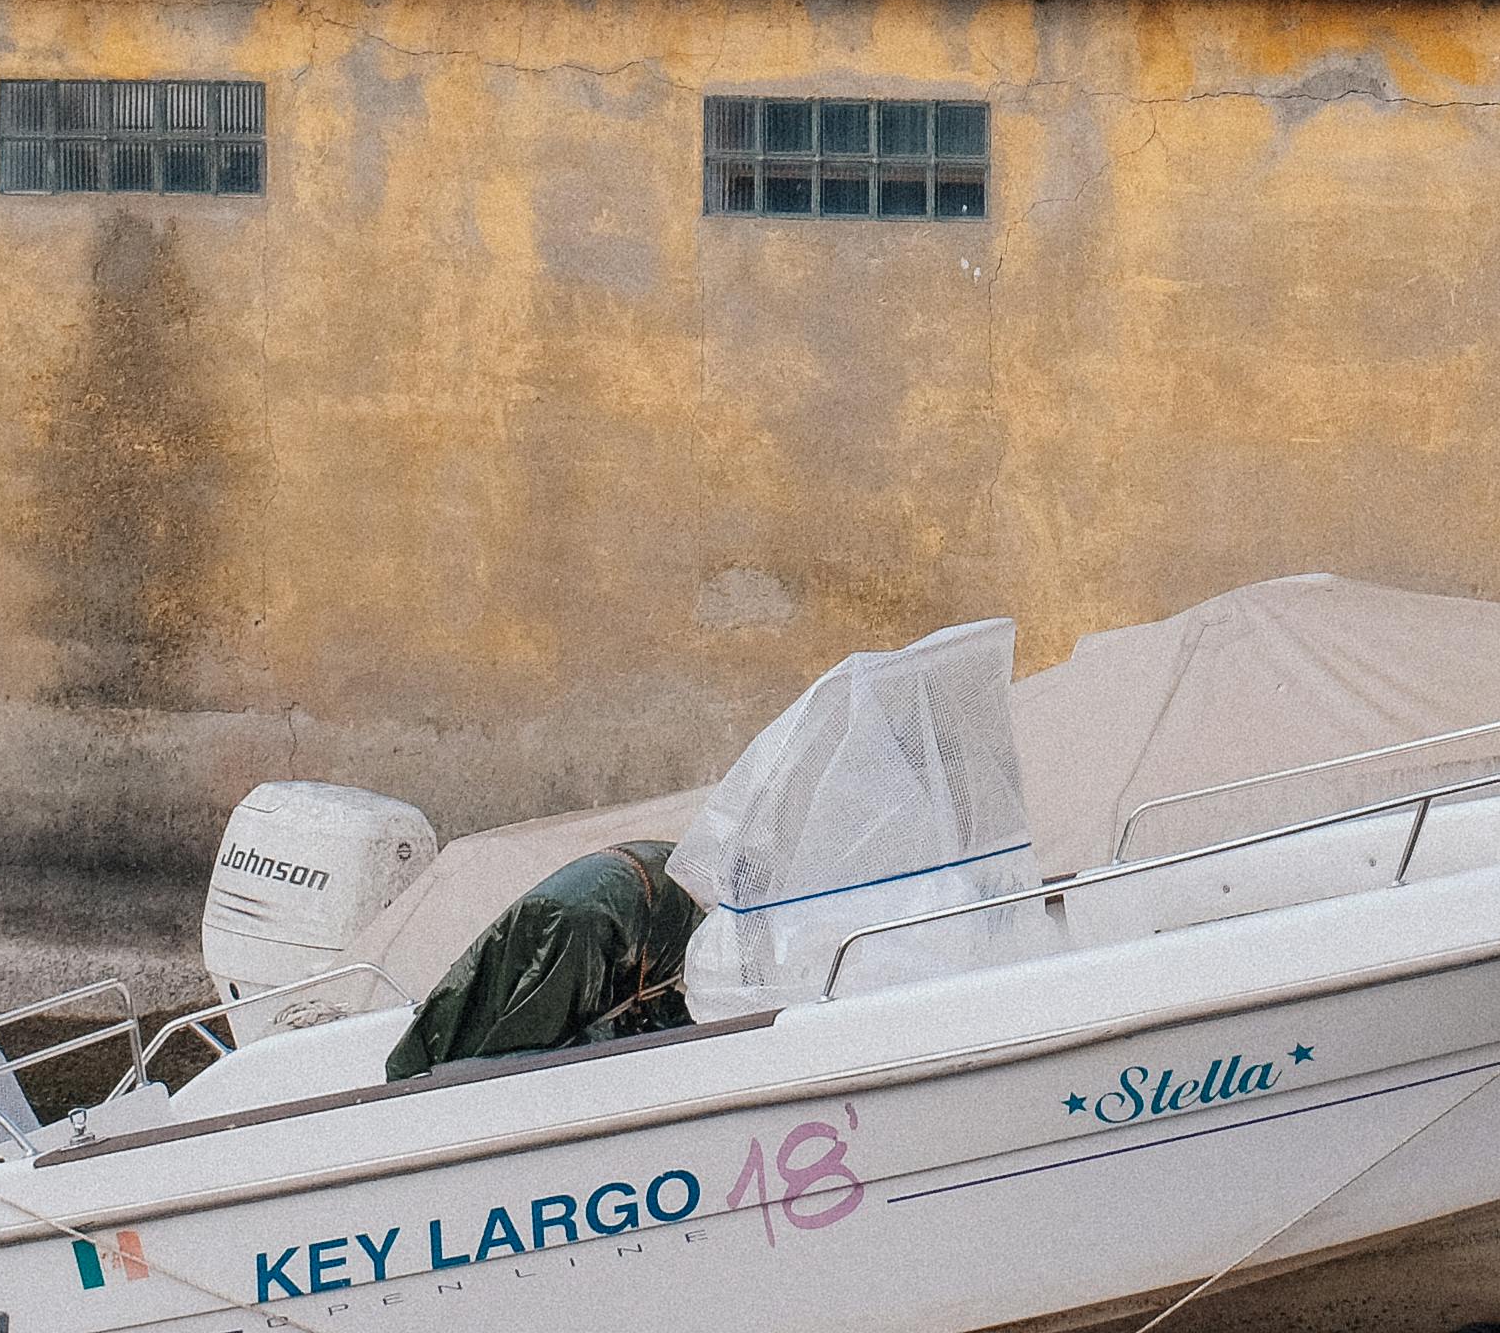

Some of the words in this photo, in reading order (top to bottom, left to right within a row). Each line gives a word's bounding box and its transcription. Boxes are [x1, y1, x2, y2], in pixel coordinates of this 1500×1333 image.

[220, 842, 331, 891] Johnson
[1094, 1054, 1282, 1124] Stella
[256, 1226, 402, 1304] KEY
[429, 1169, 702, 1270] LARGO
[266, 1280, 463, 1328] OPEN
[514, 1229, 709, 1278] LINE
